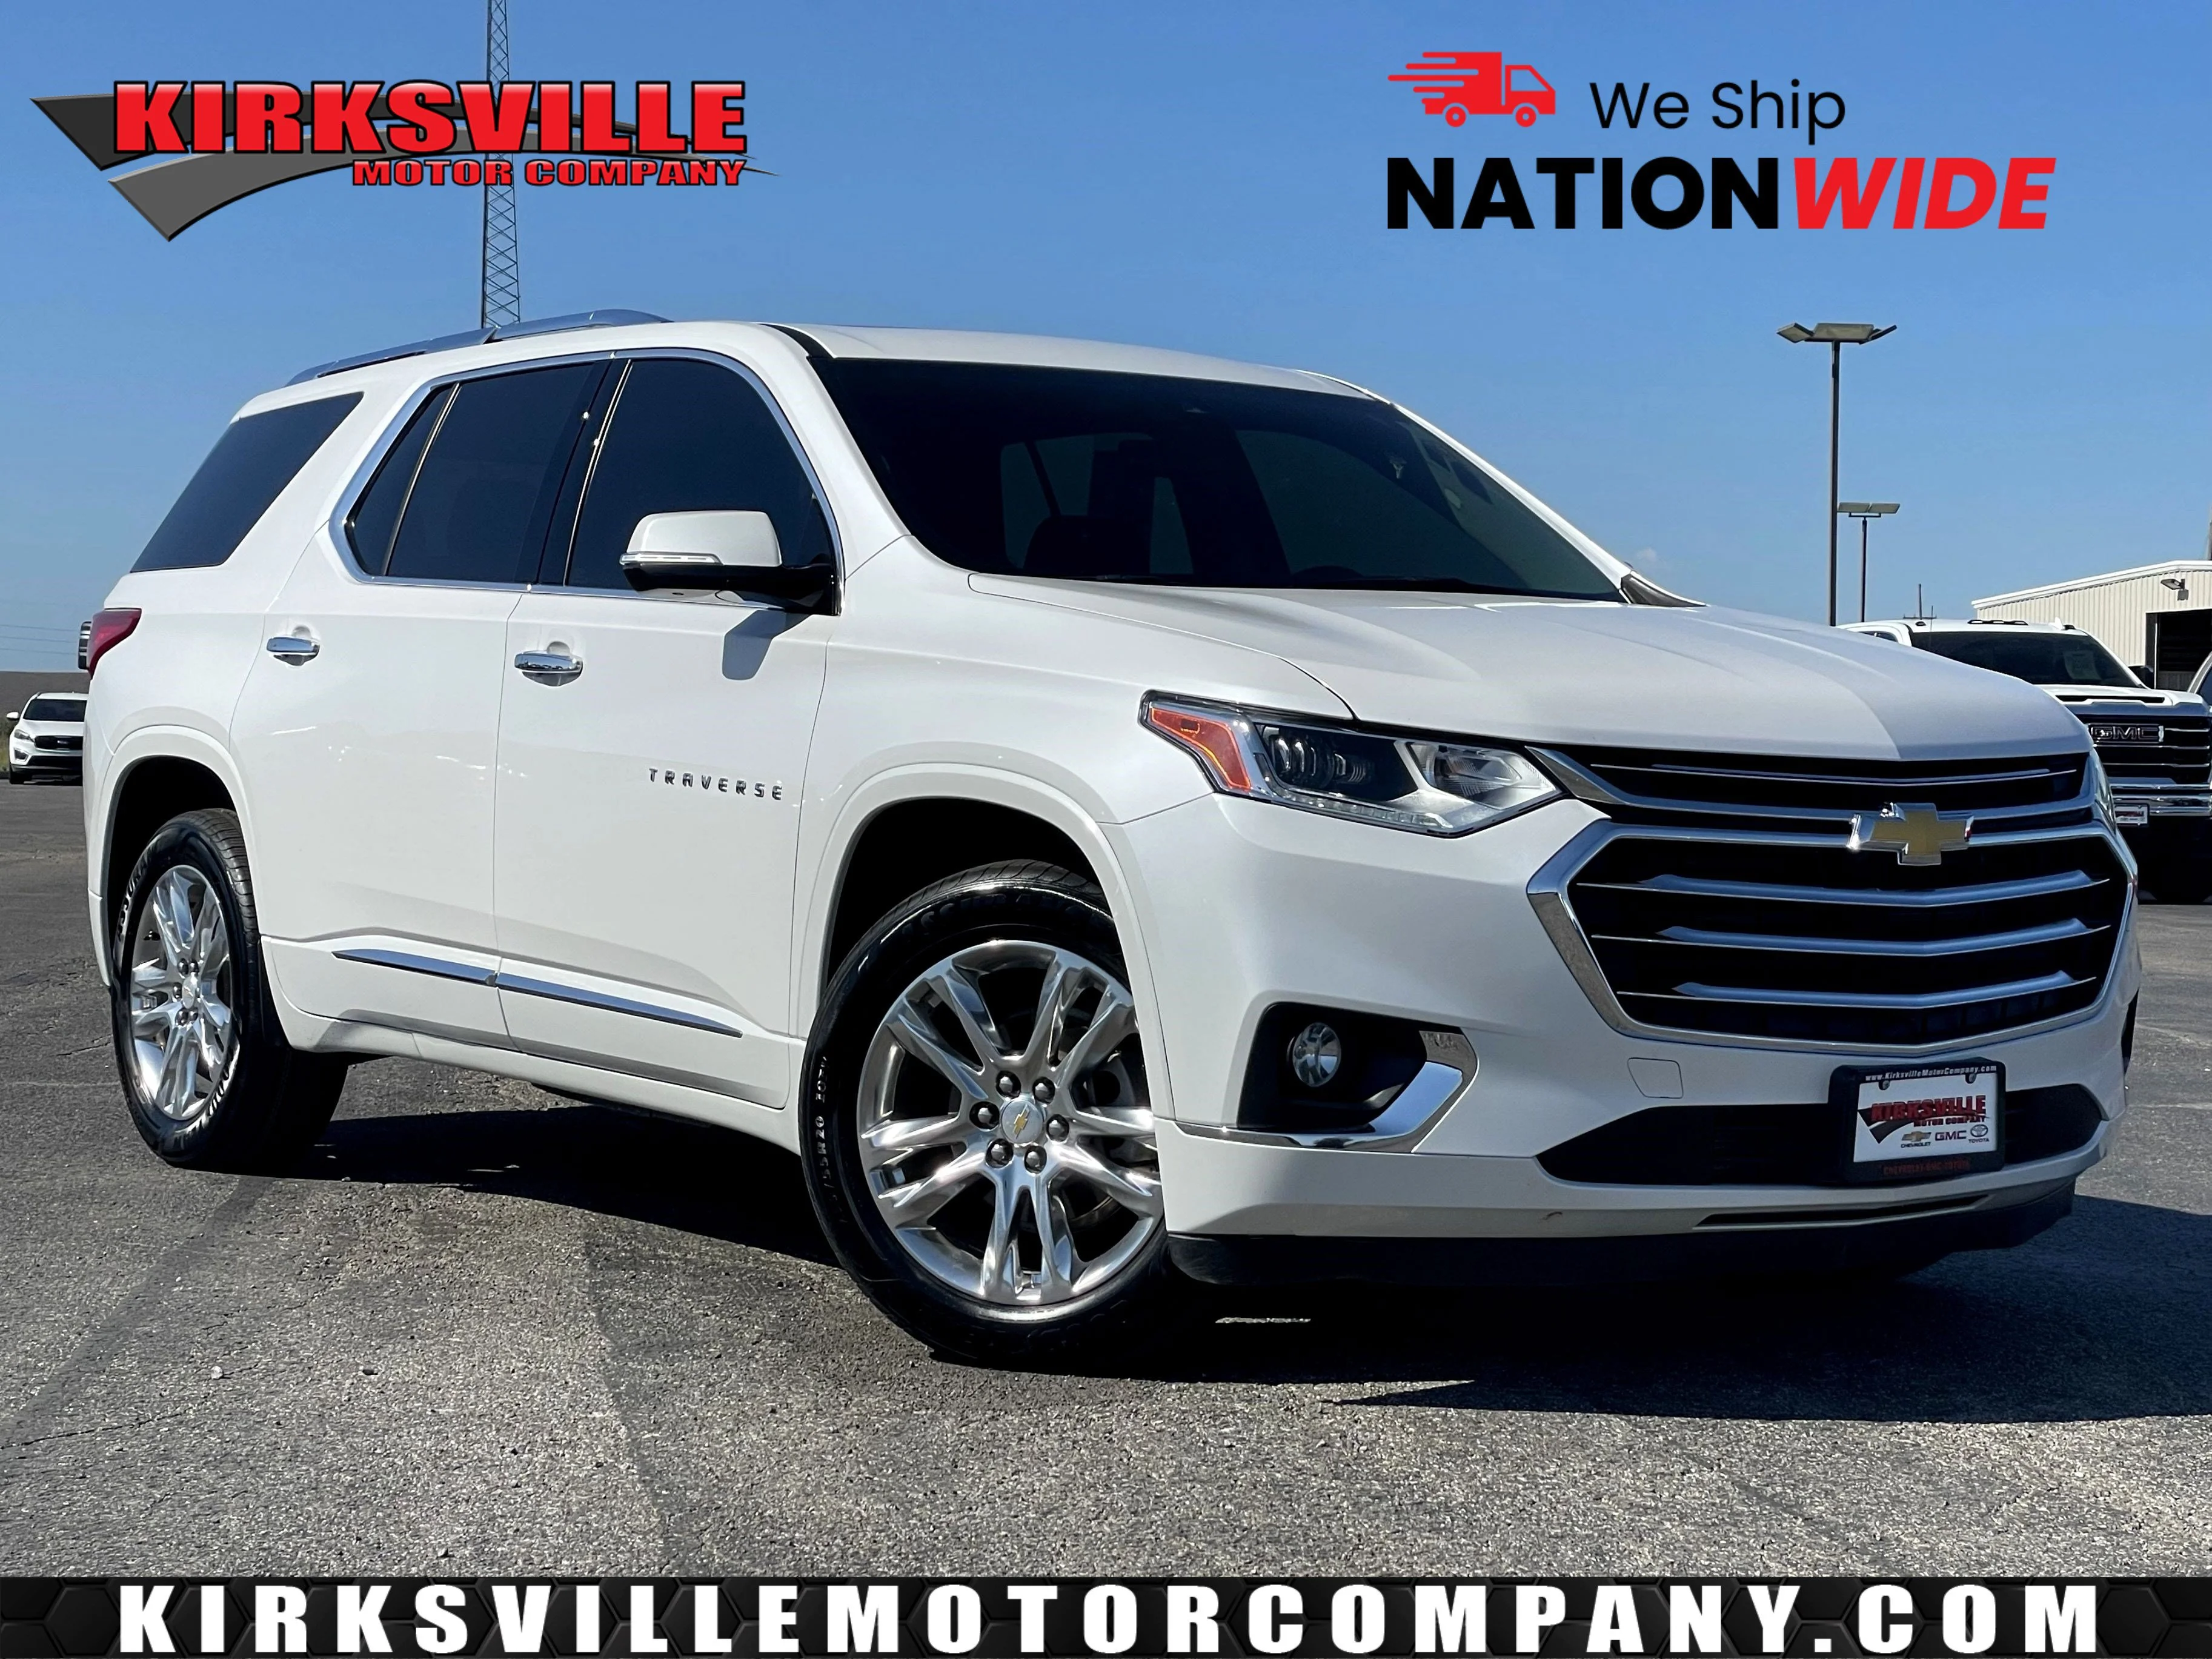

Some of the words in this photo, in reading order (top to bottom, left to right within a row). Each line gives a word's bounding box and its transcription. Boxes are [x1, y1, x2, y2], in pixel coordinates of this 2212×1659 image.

[2090, 726, 2159, 740] GMC
[649, 768, 782, 800] TRAVERSE
[1865, 1065, 1997, 1082] www.KirksvilleMotorCompany.com
[1871, 1095, 1986, 1122] KIRKSVILLE
[1935, 1130, 1967, 1141] GMC
